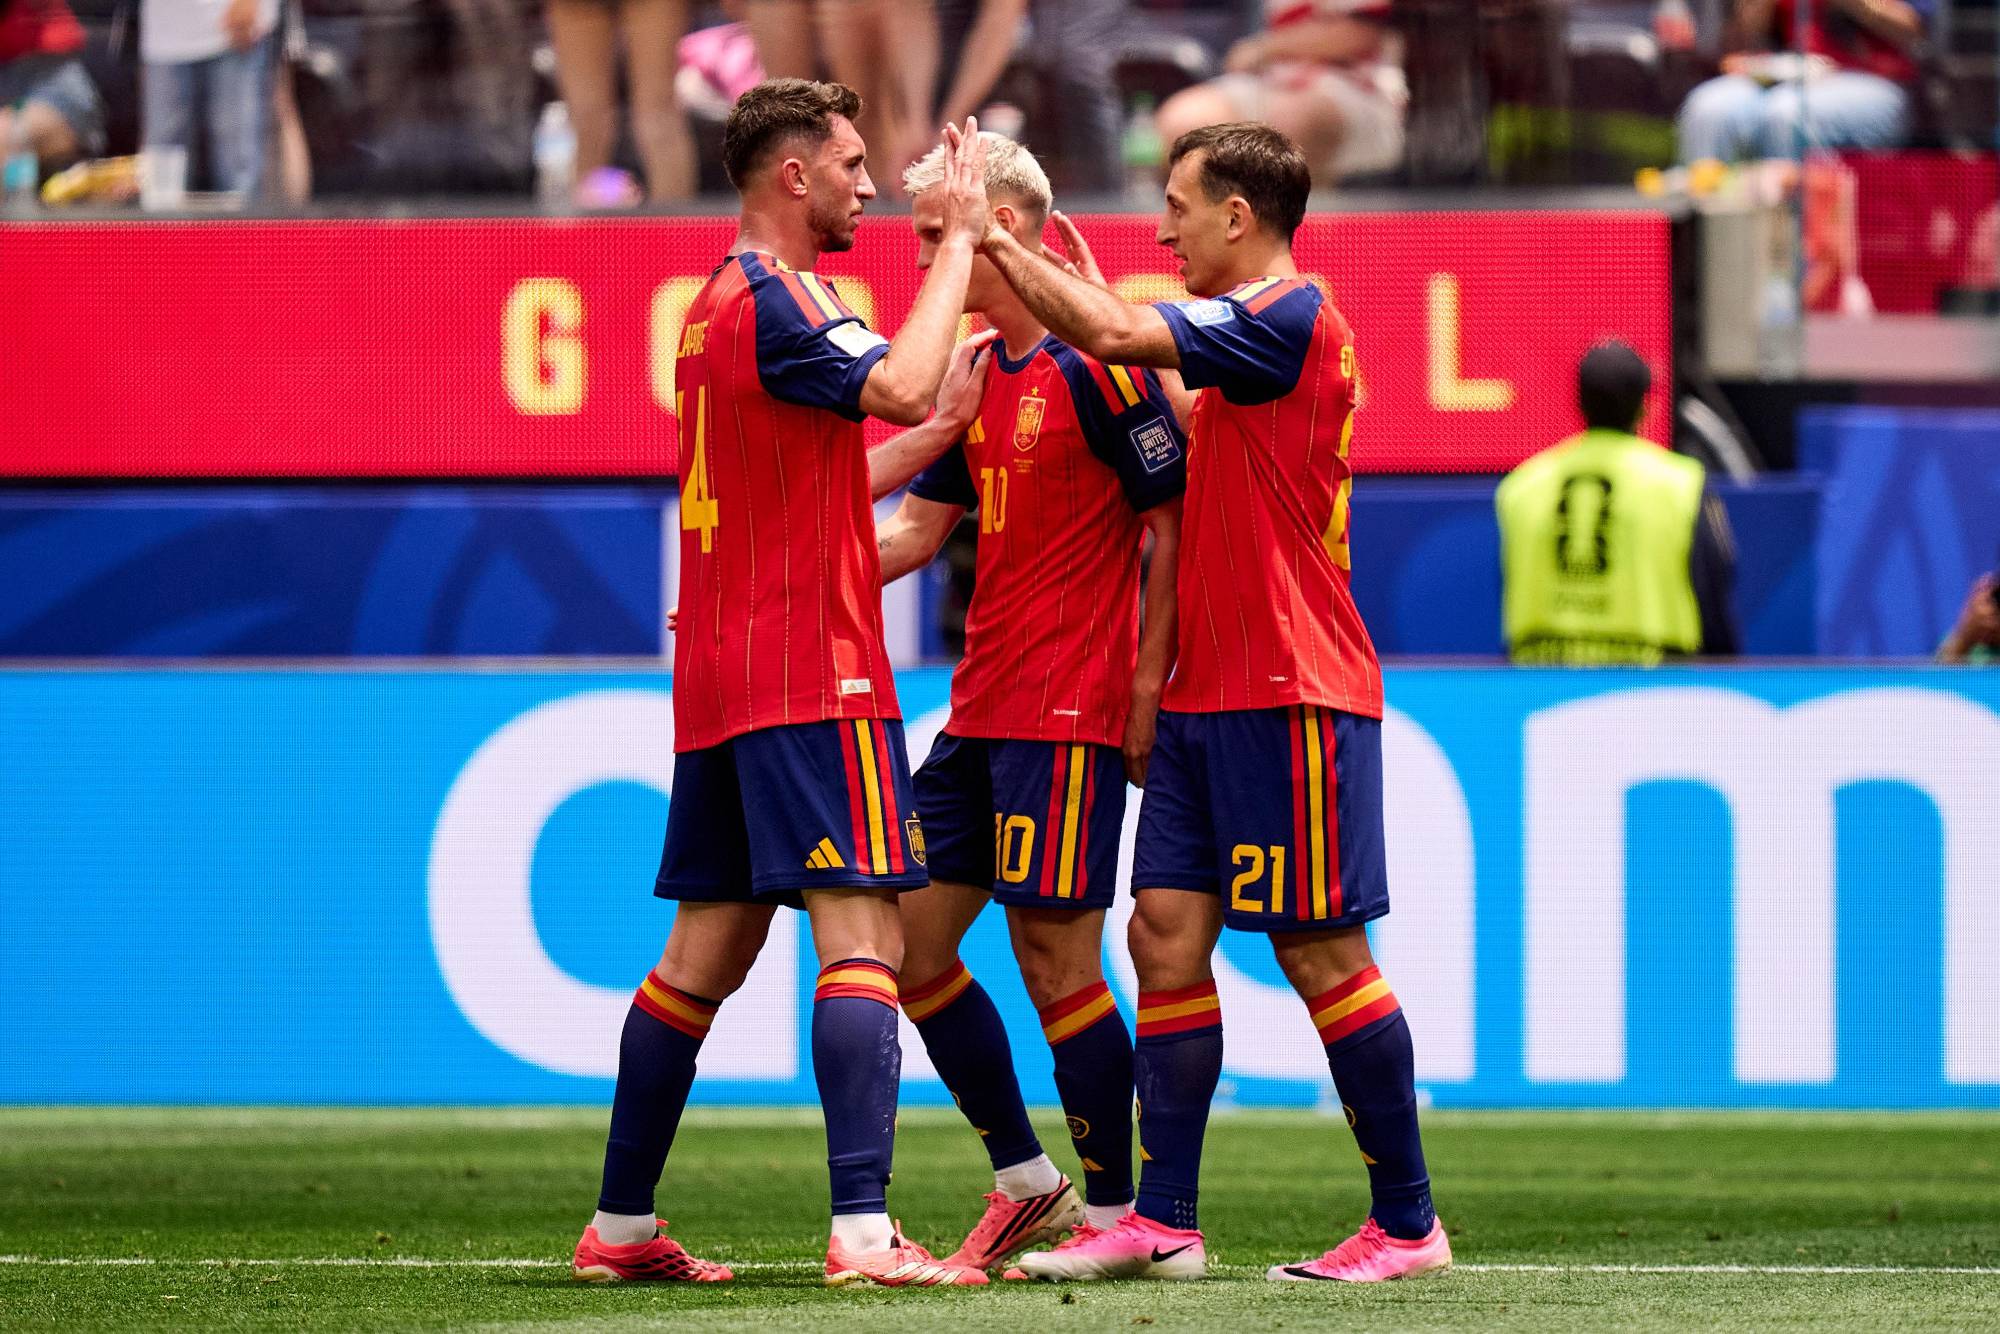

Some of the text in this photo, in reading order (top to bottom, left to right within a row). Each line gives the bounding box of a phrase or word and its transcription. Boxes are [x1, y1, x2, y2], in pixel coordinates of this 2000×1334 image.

[1137, 424, 1165, 442] FOOTBALL
[1141, 430, 1168, 451] UNITES
[981, 466, 1008, 534] 10
[1231, 844, 1285, 915] 21
